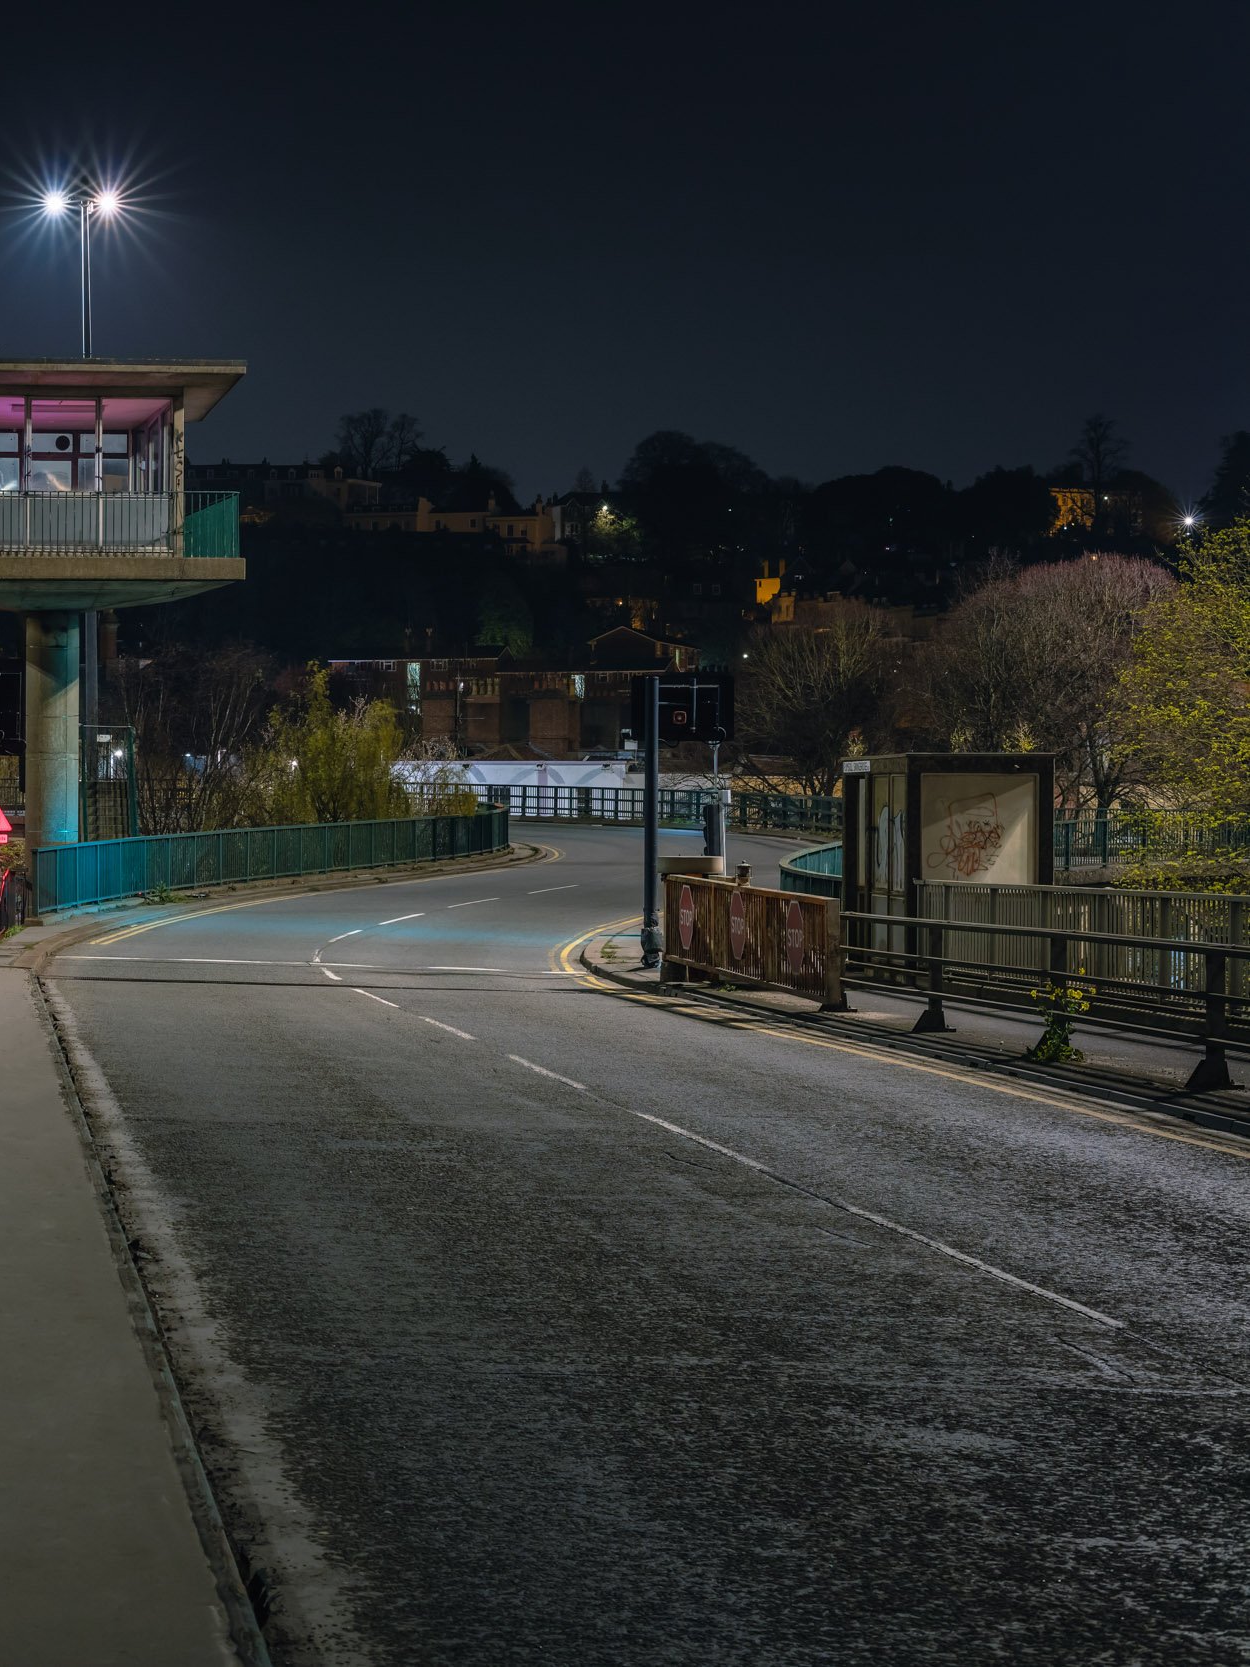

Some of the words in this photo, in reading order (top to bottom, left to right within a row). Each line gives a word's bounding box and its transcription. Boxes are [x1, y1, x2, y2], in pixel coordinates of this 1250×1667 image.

[680, 909, 693, 927] STOP
[731, 916, 745, 935] STOP
[787, 929, 803, 947] STOP
